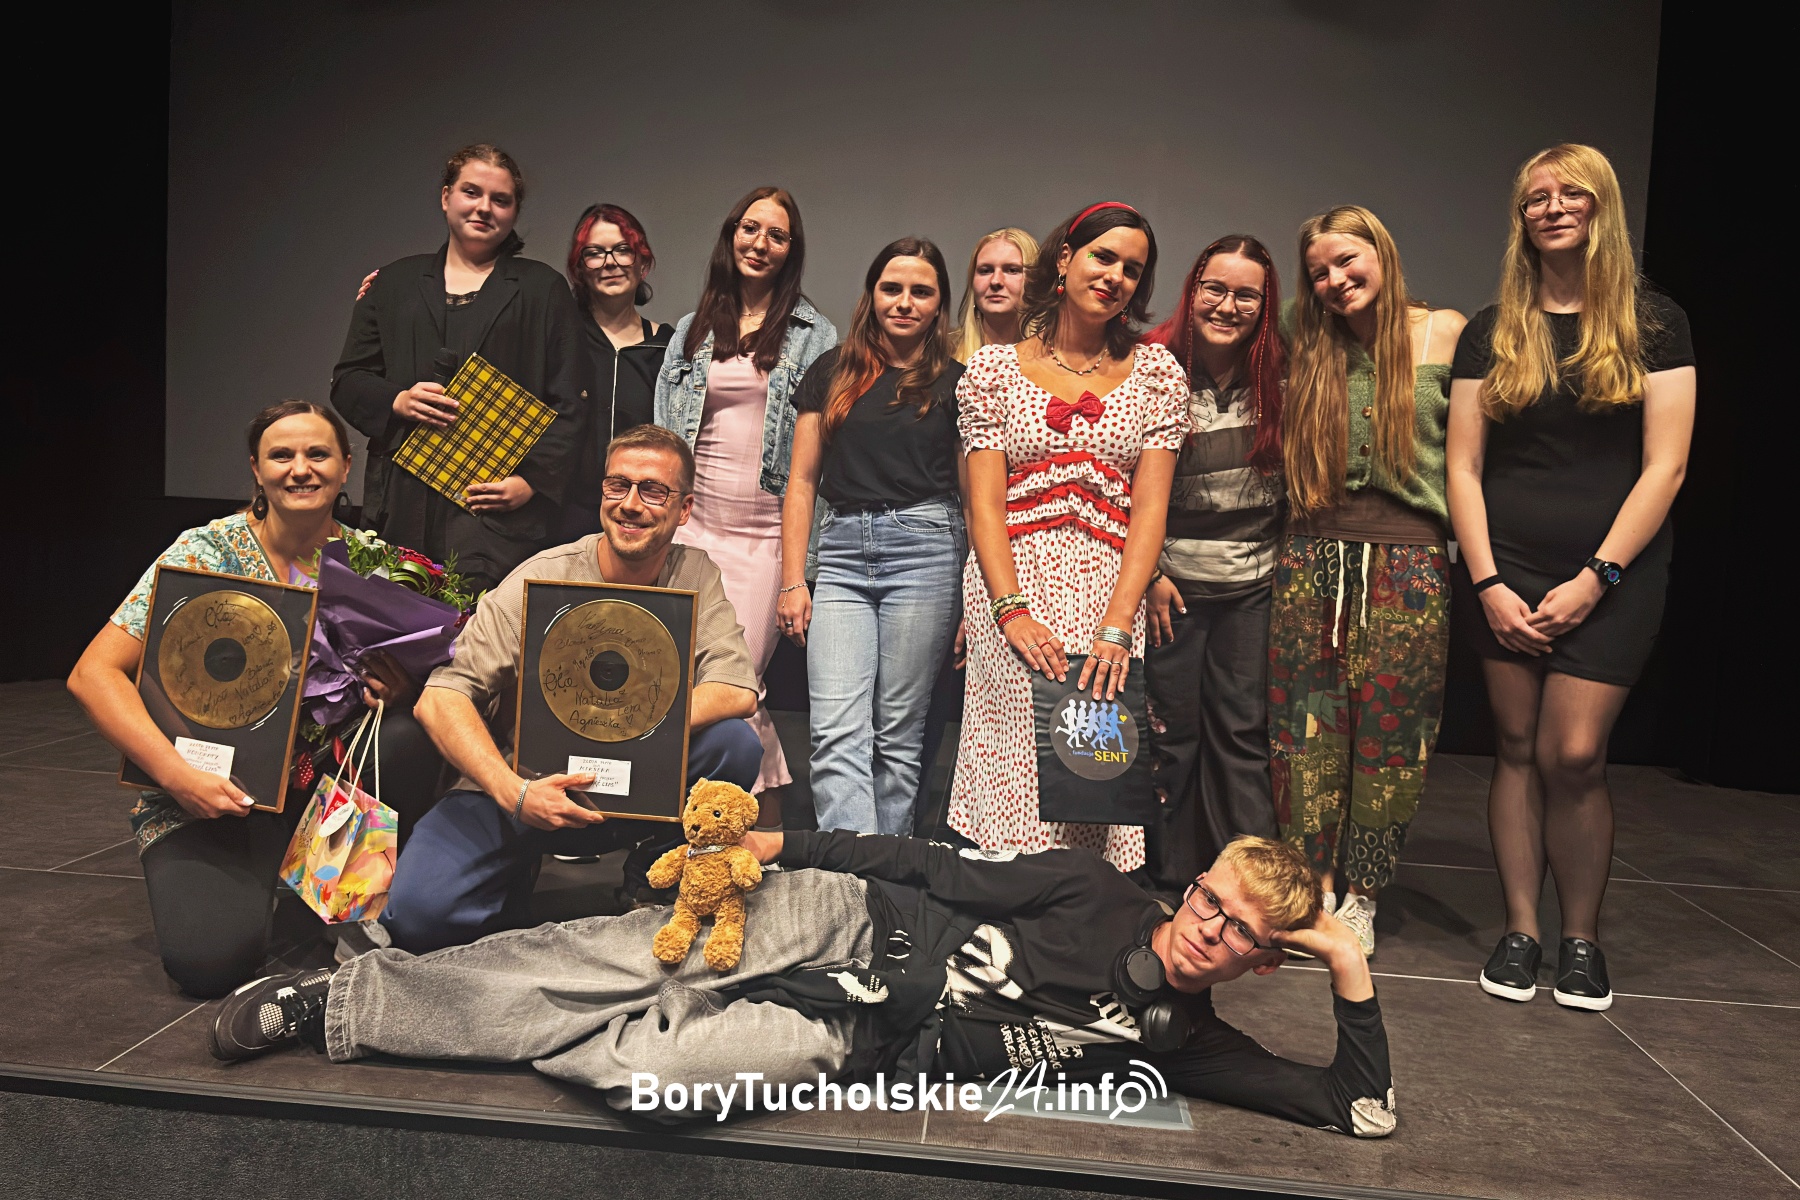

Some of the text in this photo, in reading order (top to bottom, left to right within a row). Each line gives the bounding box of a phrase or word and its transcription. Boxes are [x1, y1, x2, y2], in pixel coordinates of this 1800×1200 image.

[575, 689, 623, 706] Natalia
[569, 709, 621, 732] Agnieszka
[1094, 750, 1129, 763] SENT
